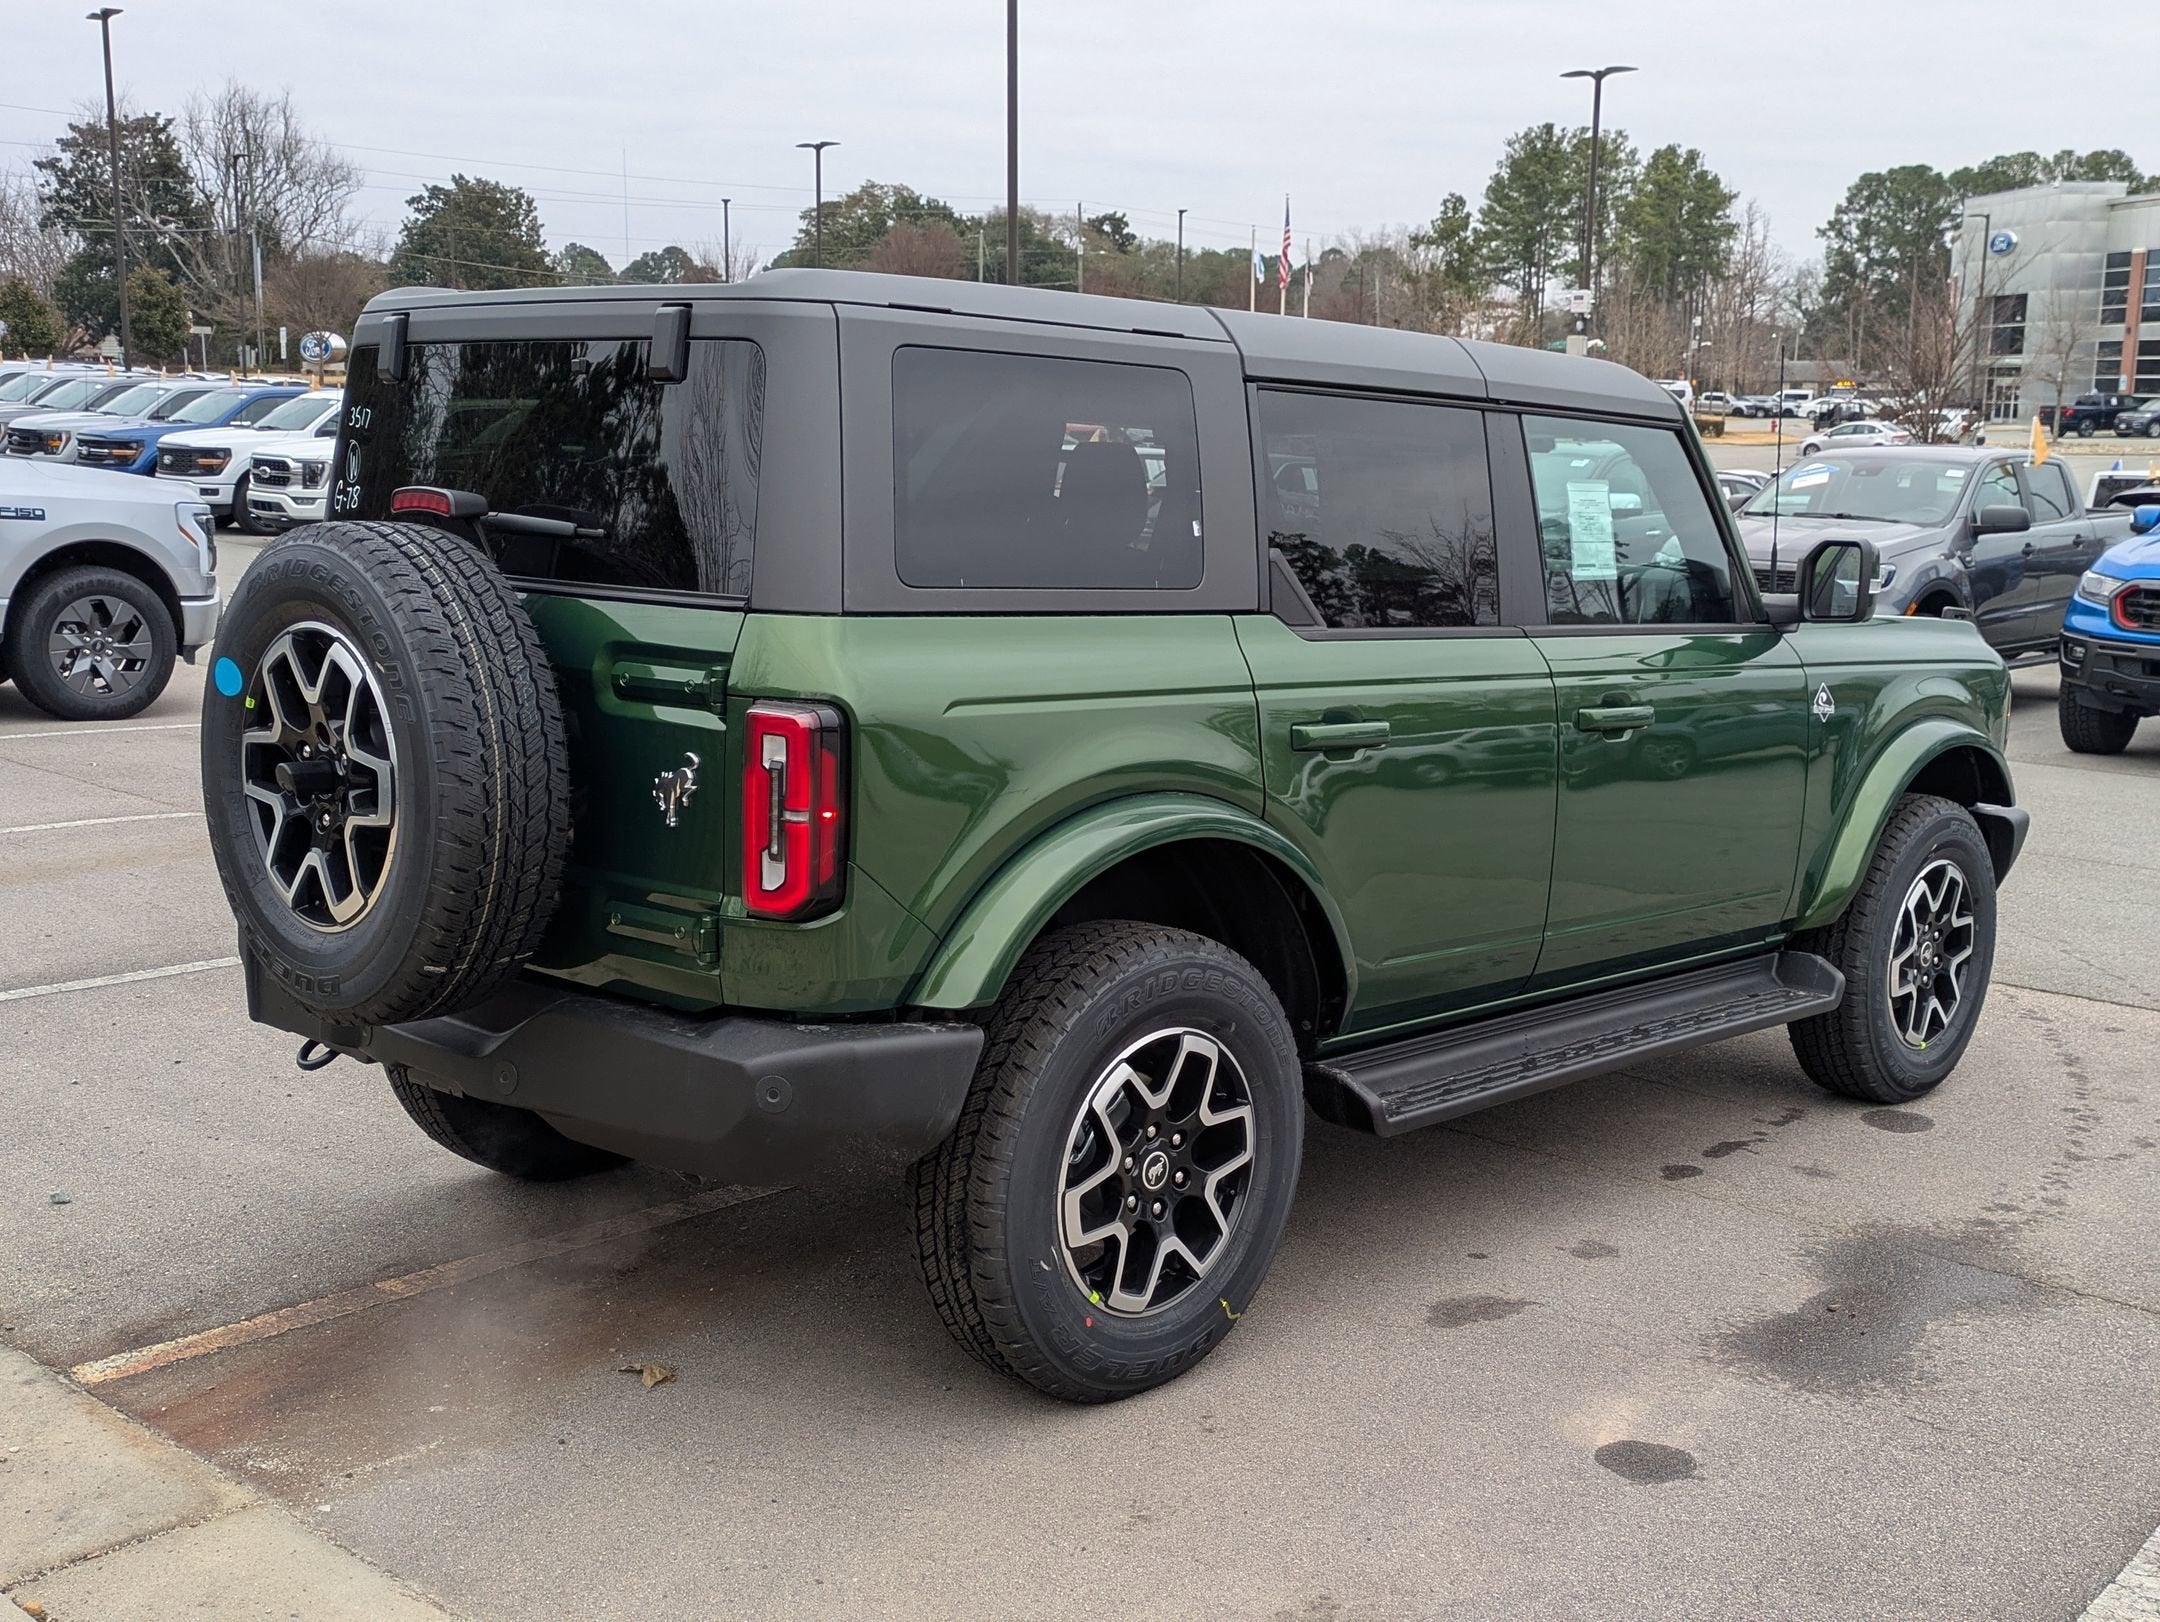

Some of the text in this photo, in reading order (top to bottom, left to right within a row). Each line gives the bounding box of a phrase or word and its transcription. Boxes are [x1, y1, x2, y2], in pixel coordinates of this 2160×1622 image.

[348, 405, 371, 430] 3517
[246, 558, 417, 724] BRIDGESTONE
[1096, 967, 1291, 1067] BRIDGESTONE
[1050, 1322, 1218, 1379] DUELER
